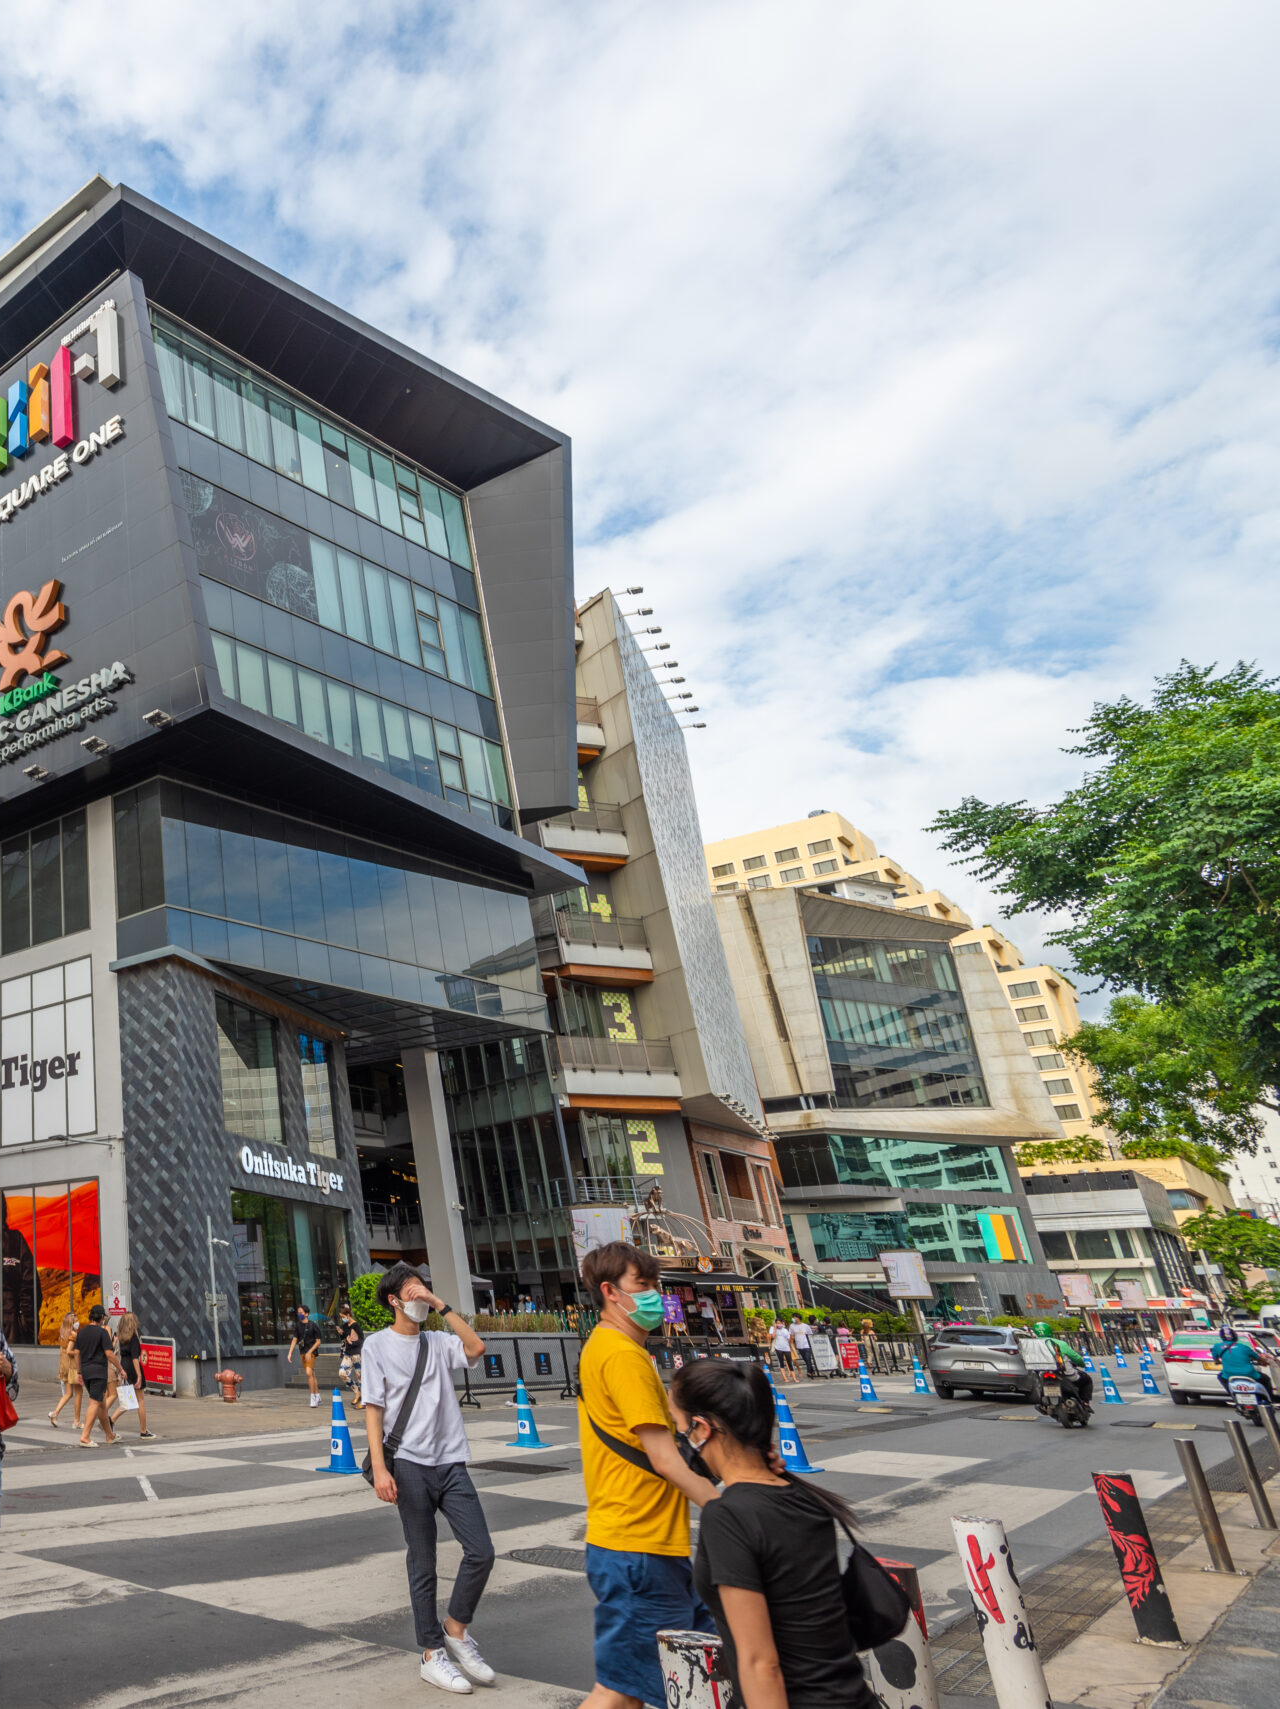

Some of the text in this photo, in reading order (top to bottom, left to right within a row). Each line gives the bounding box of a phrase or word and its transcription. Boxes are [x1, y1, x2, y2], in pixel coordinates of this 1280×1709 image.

[73, 414, 124, 464] ONE
[0, 672, 59, 718] KBank
[1, 712, 76, 762] performing
[80, 696, 112, 719] arts
[601, 991, 638, 1044] 3
[241, 1146, 344, 1195] Onitsuka Tiger
[625, 1120, 665, 1175] 2
